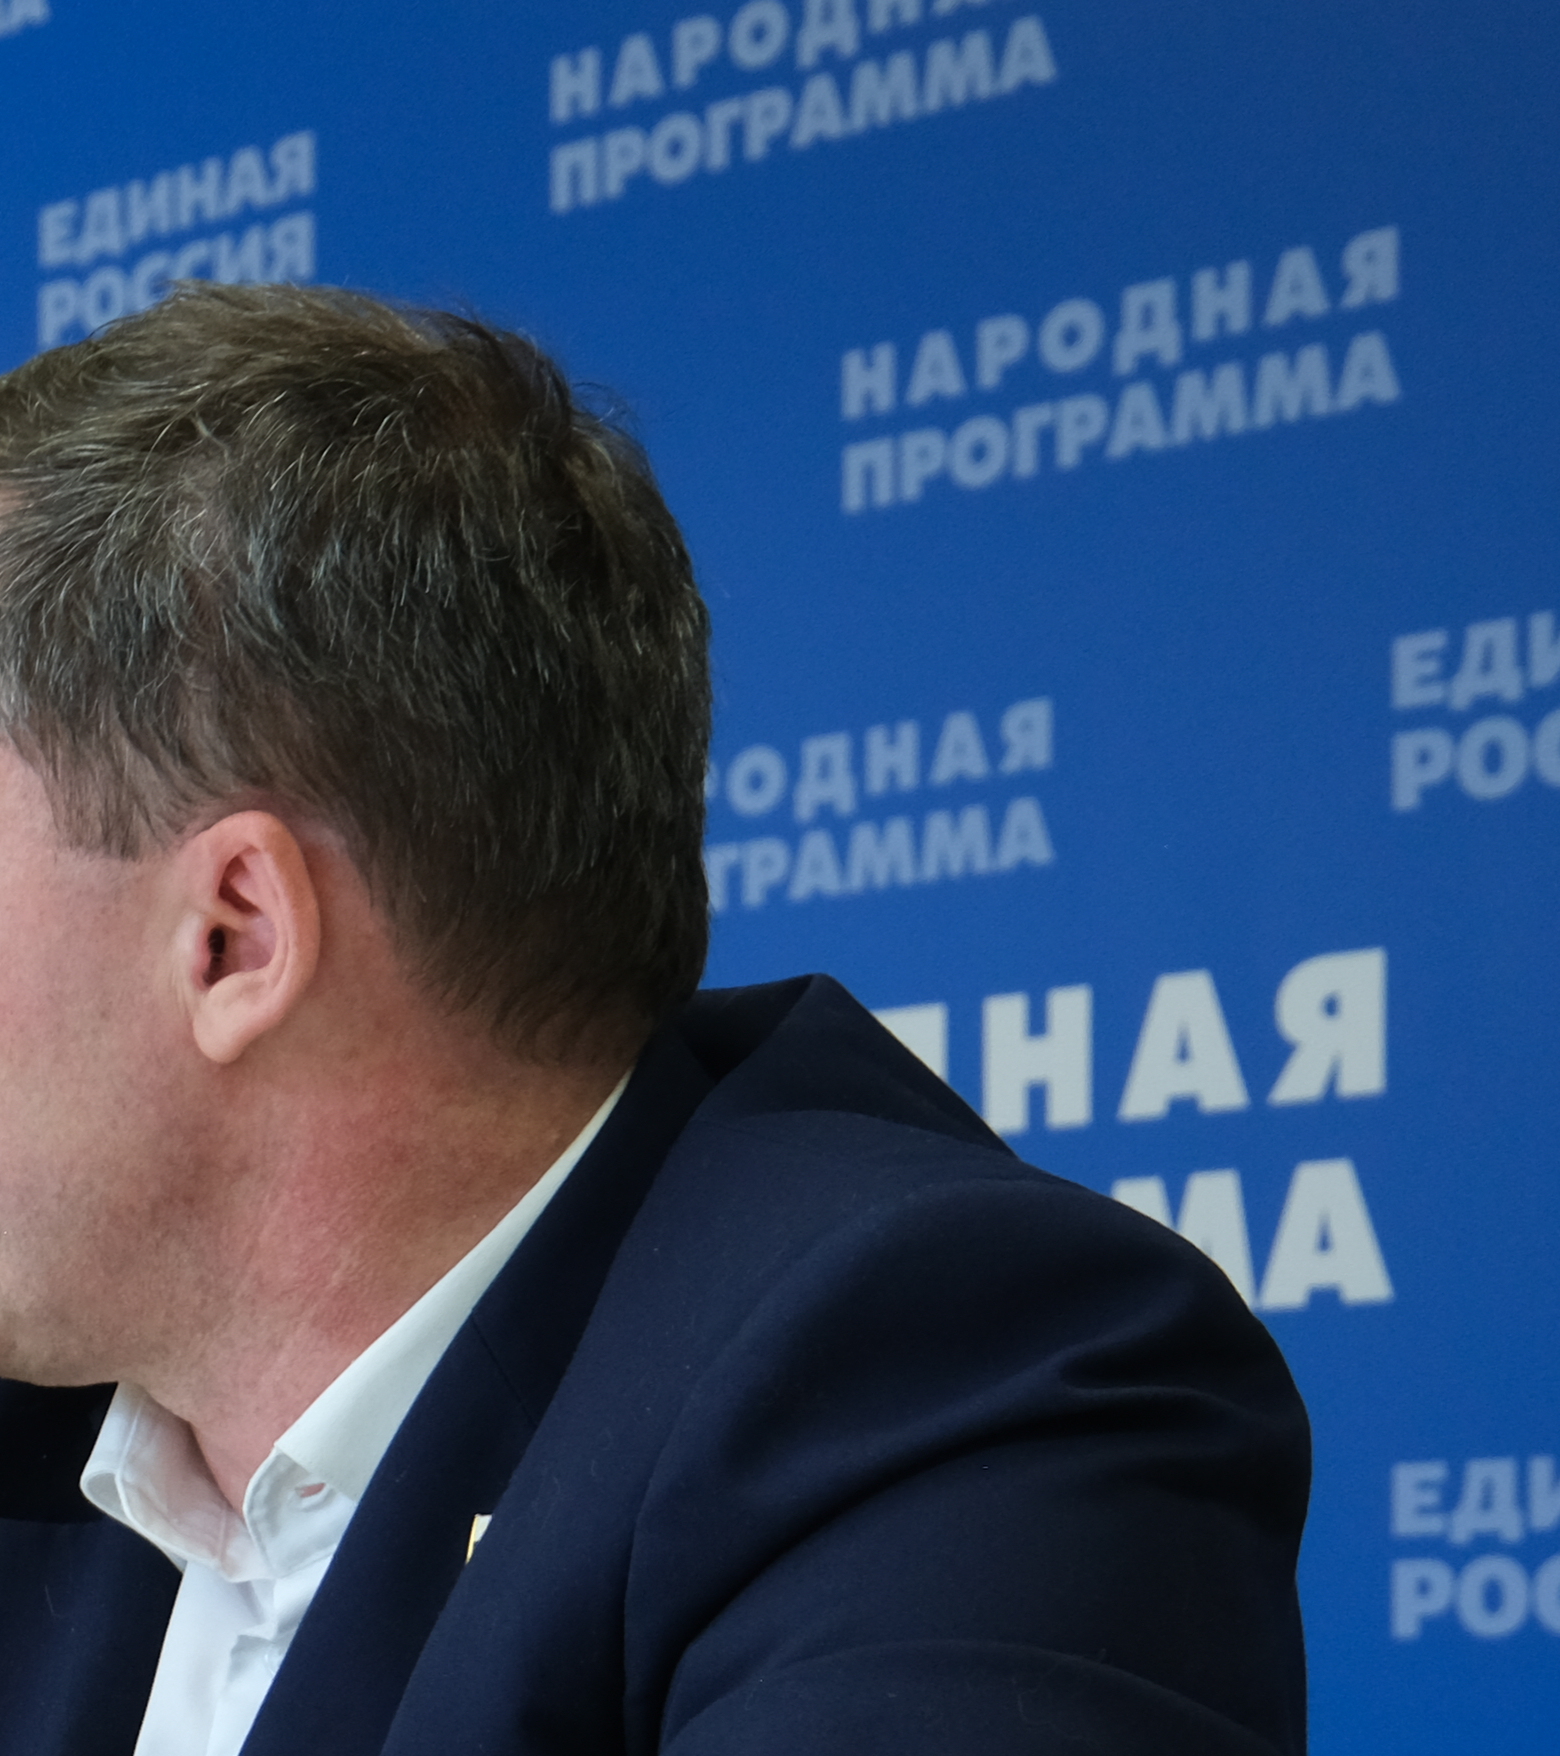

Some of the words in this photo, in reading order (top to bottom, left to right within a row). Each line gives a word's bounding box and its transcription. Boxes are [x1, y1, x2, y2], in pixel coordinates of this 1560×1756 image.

[38, 130, 317, 268] ЕДИНАЯ
[549, 15, 1058, 213] ПРОГРАММА
[841, 226, 1401, 421] НАРОДНАЯ
[841, 332, 1401, 516] ПРОГРАММА
